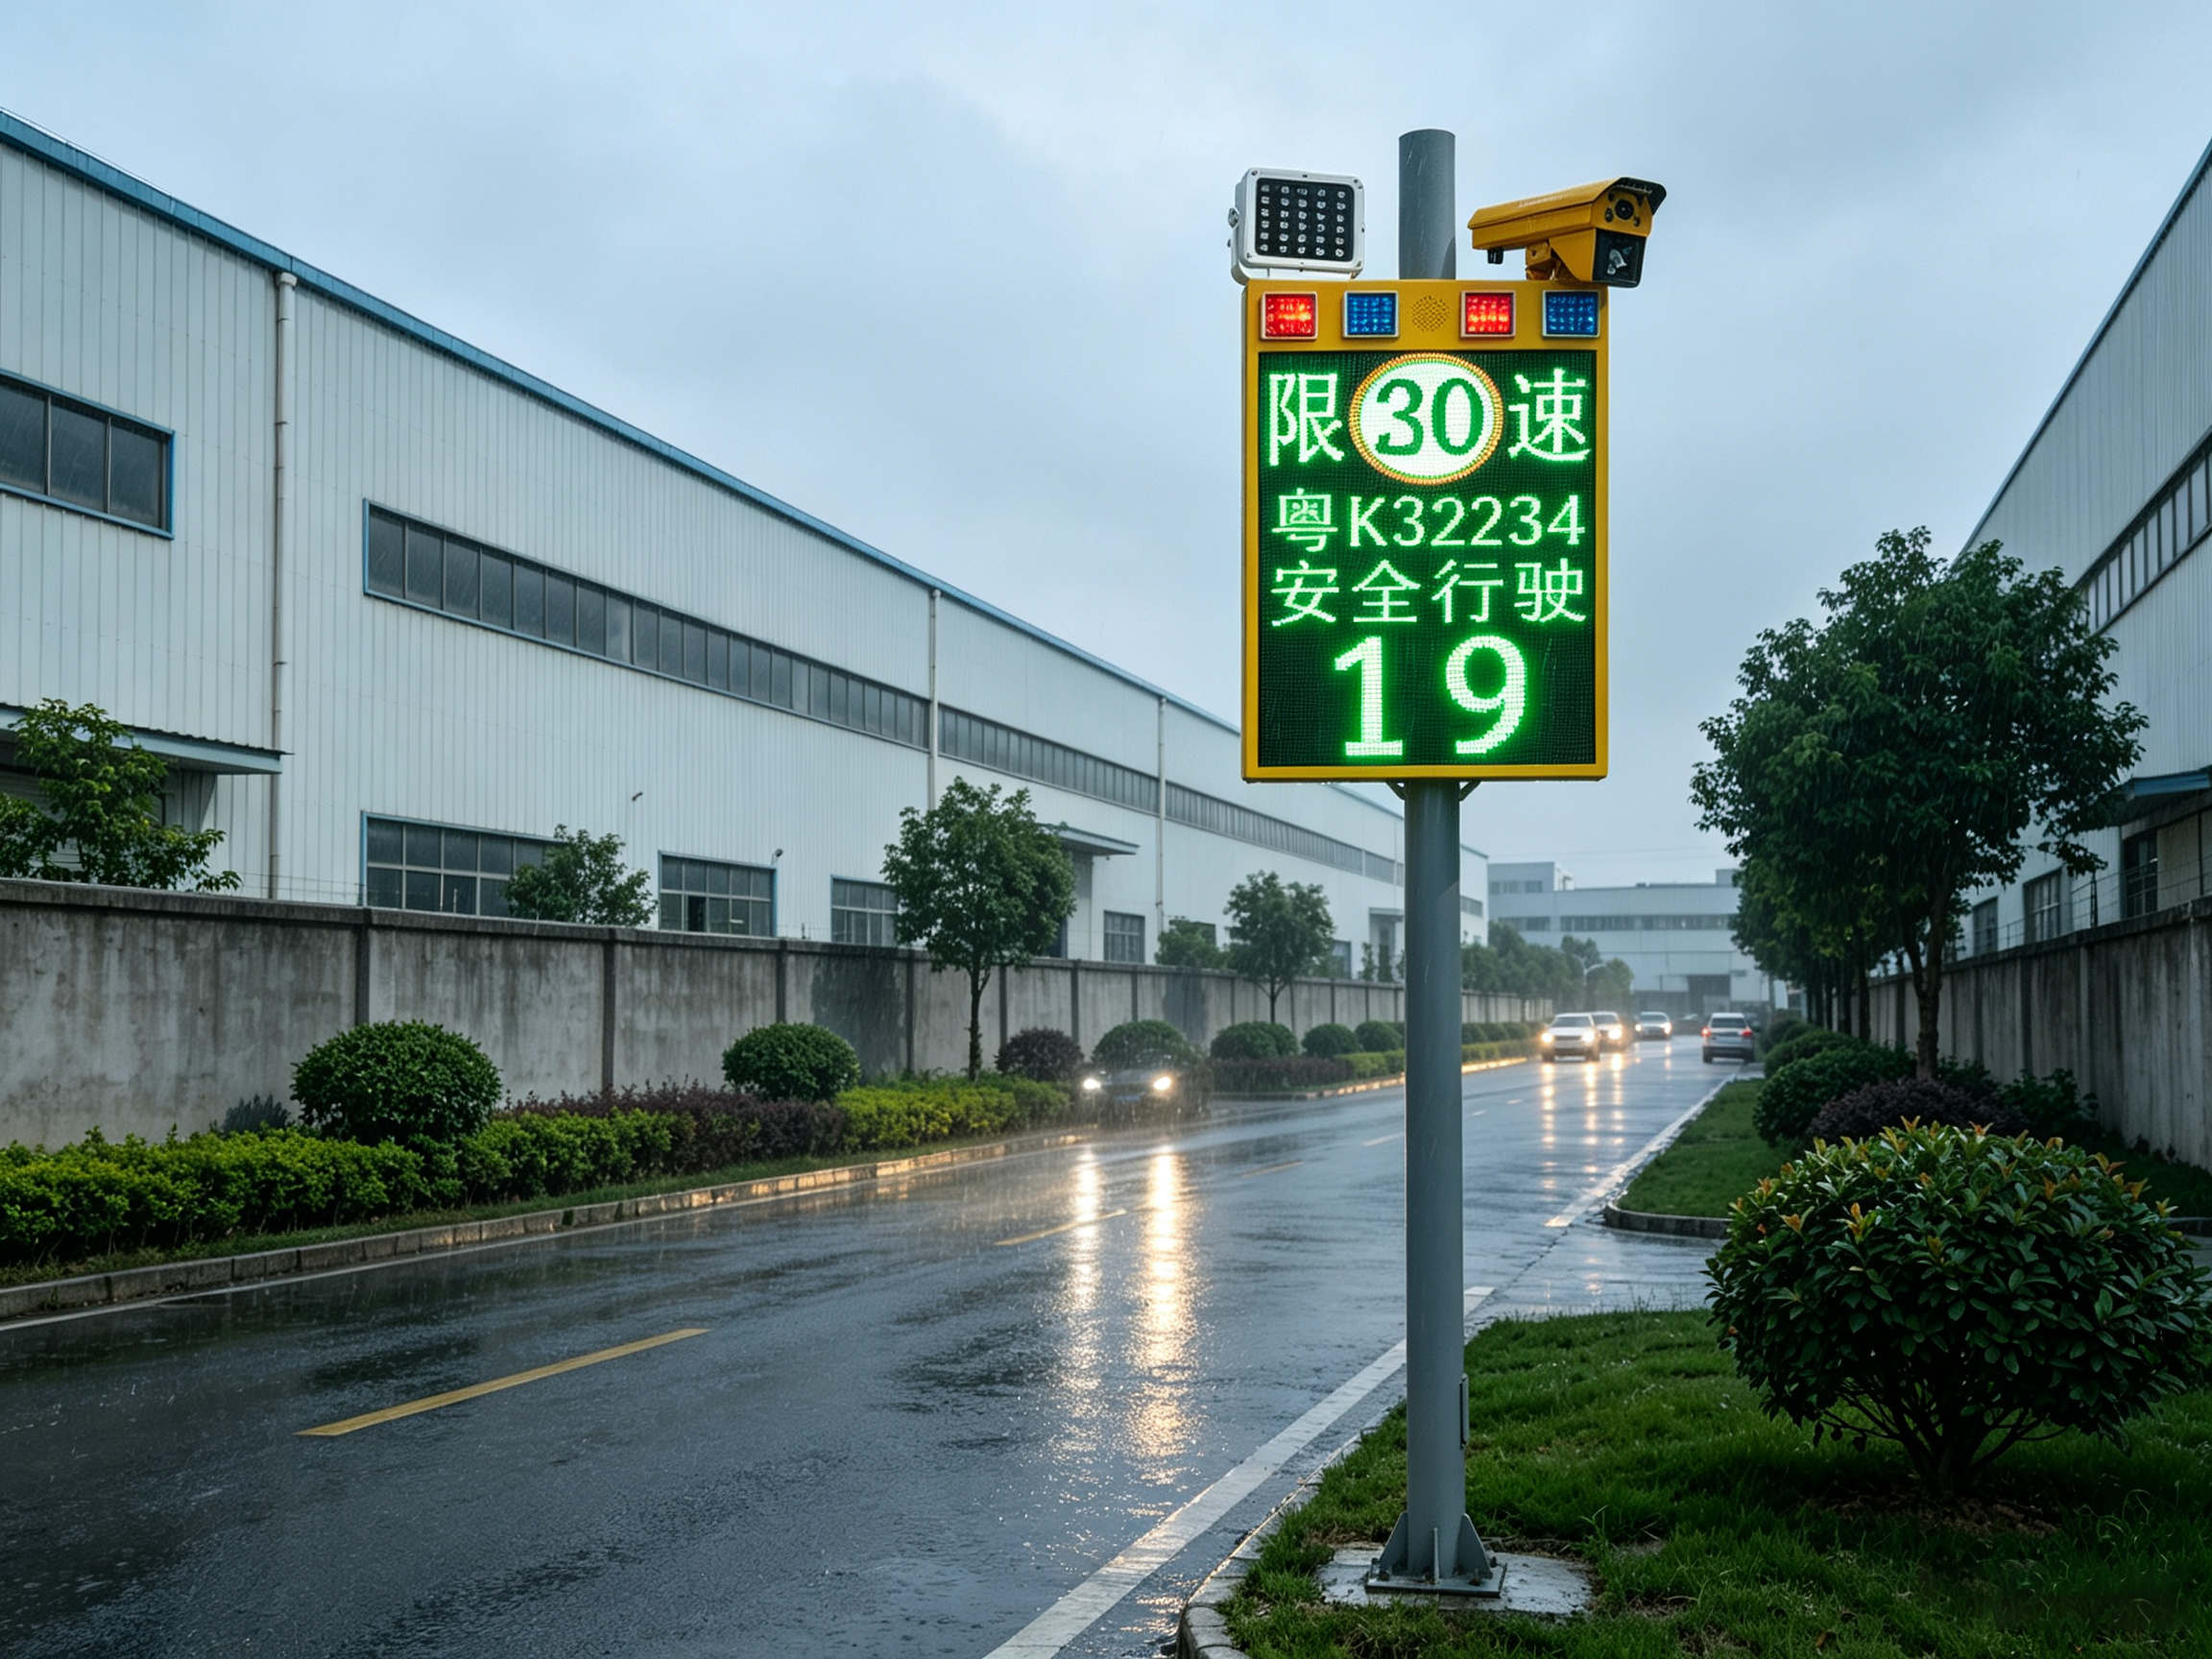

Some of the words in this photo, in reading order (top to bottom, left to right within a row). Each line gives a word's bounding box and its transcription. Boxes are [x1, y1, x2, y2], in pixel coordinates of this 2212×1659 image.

[1268, 372, 1345, 467] 限
[1376, 378, 1484, 456] 30
[1507, 368, 1591, 463] 速
[1271, 488, 1586, 552] 粤K32234
[1270, 558, 1587, 627] 安全行驶
[1334, 635, 1527, 757] 19
